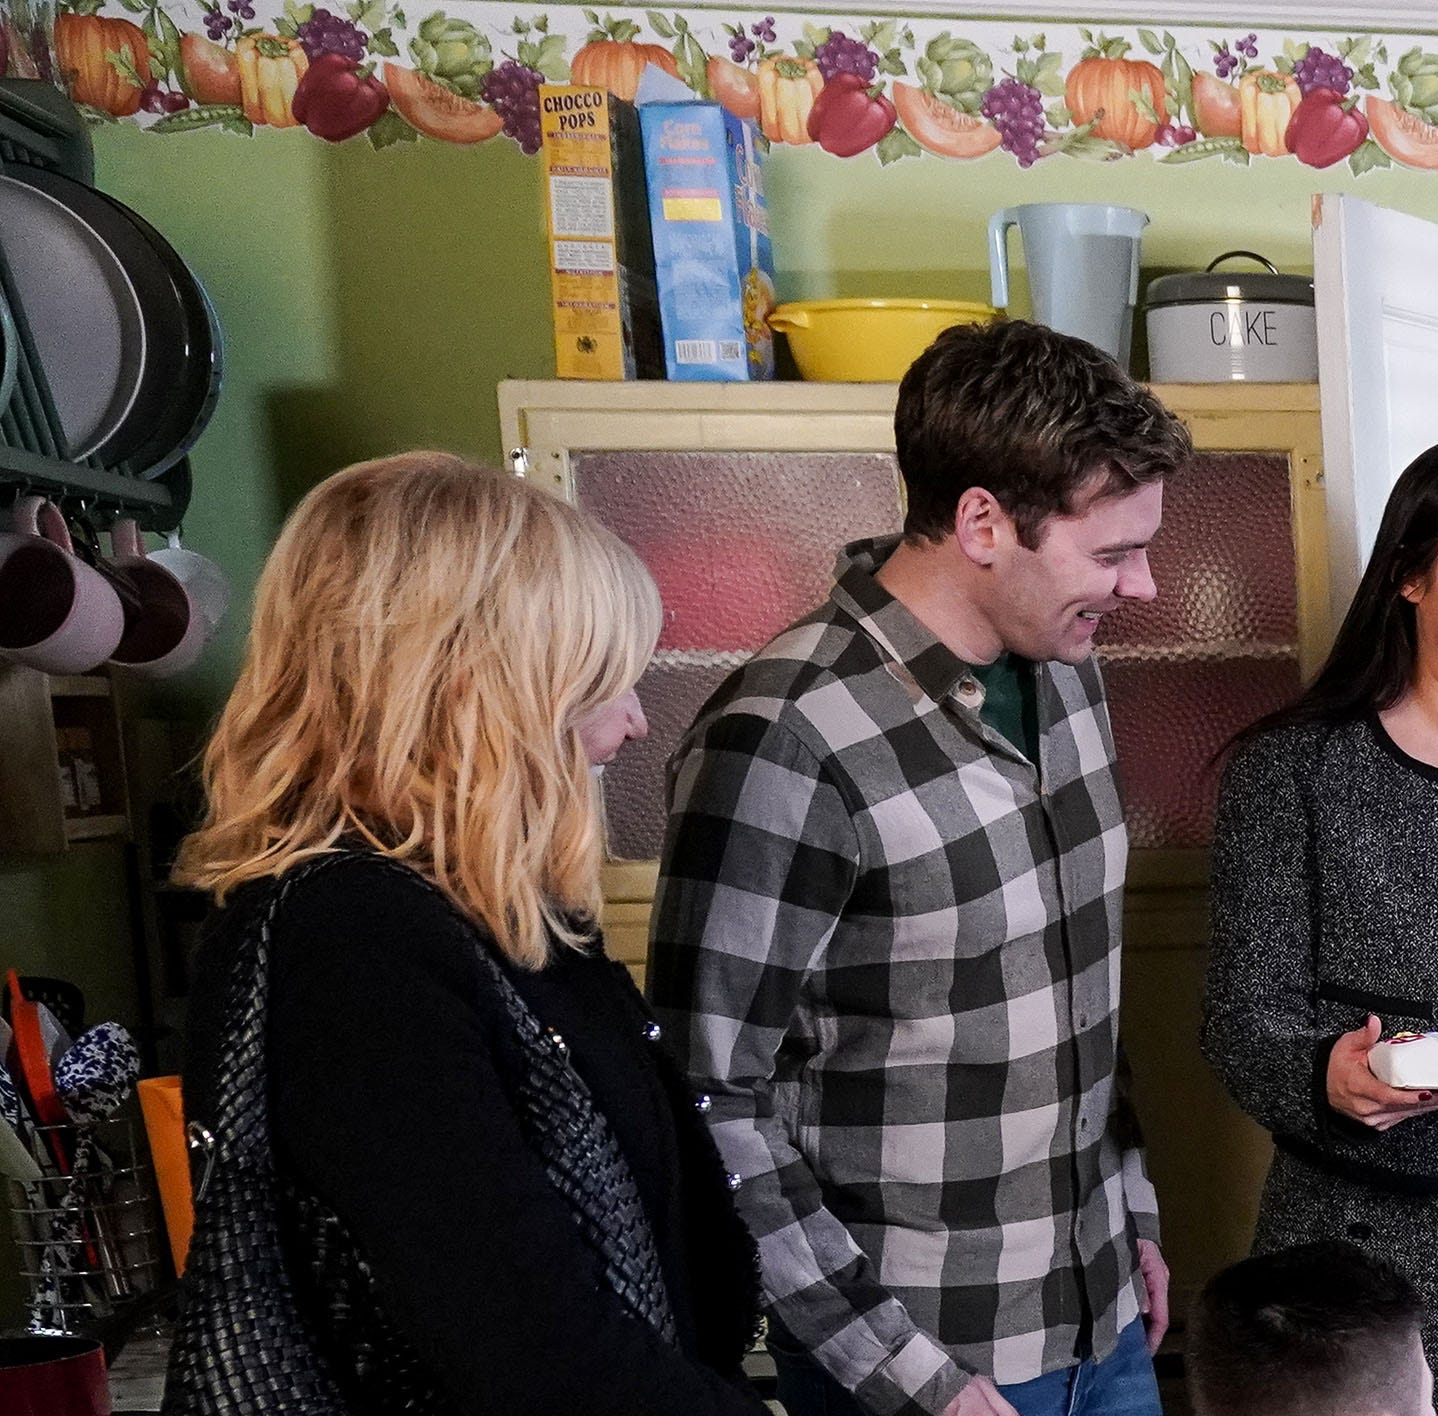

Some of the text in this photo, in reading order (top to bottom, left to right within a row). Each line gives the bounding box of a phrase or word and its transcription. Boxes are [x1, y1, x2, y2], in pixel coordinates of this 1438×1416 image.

[543, 91, 602, 113] CHOCCO
[558, 111, 595, 131] POPS
[1209, 311, 1278, 346] CAKE
